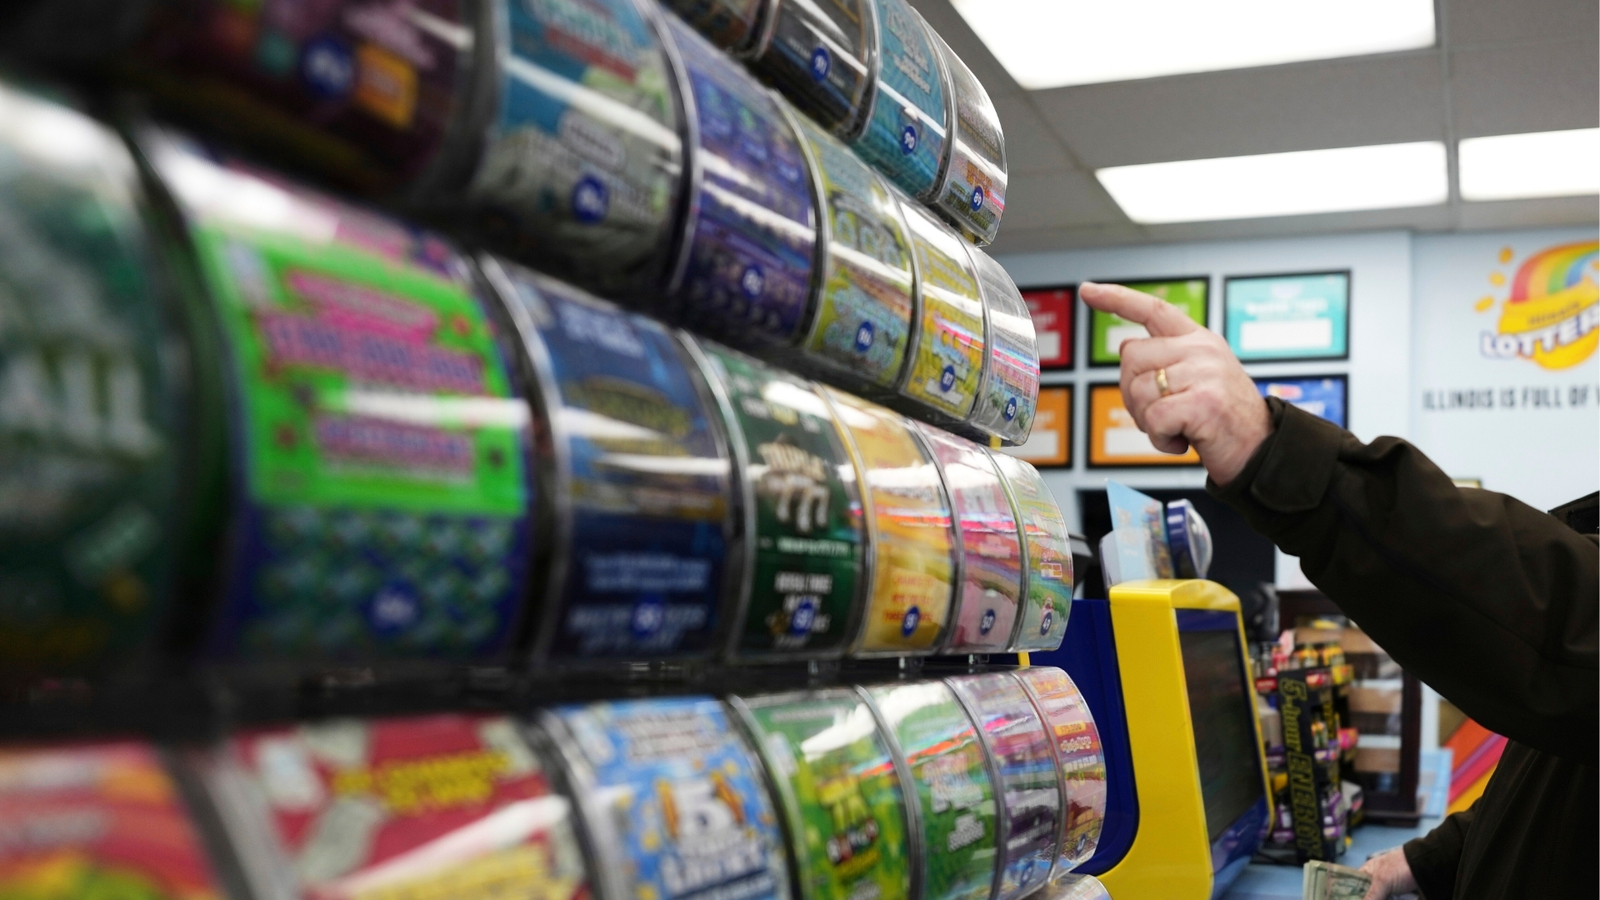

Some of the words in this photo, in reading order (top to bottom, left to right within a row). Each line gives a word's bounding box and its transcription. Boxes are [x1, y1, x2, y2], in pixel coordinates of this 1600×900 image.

[903, 132, 916, 150] 90
[972, 190, 983, 208] 89
[857, 329, 872, 346] 86
[942, 370, 955, 388] 87
[1422, 388, 1494, 412] ILLINOIS
[1500, 387, 1516, 410] IS
[1521, 385, 1562, 409] FULL
[1568, 383, 1590, 408] OF
[1006, 401, 1017, 415] 88
[1042, 616, 1052, 631] 49
